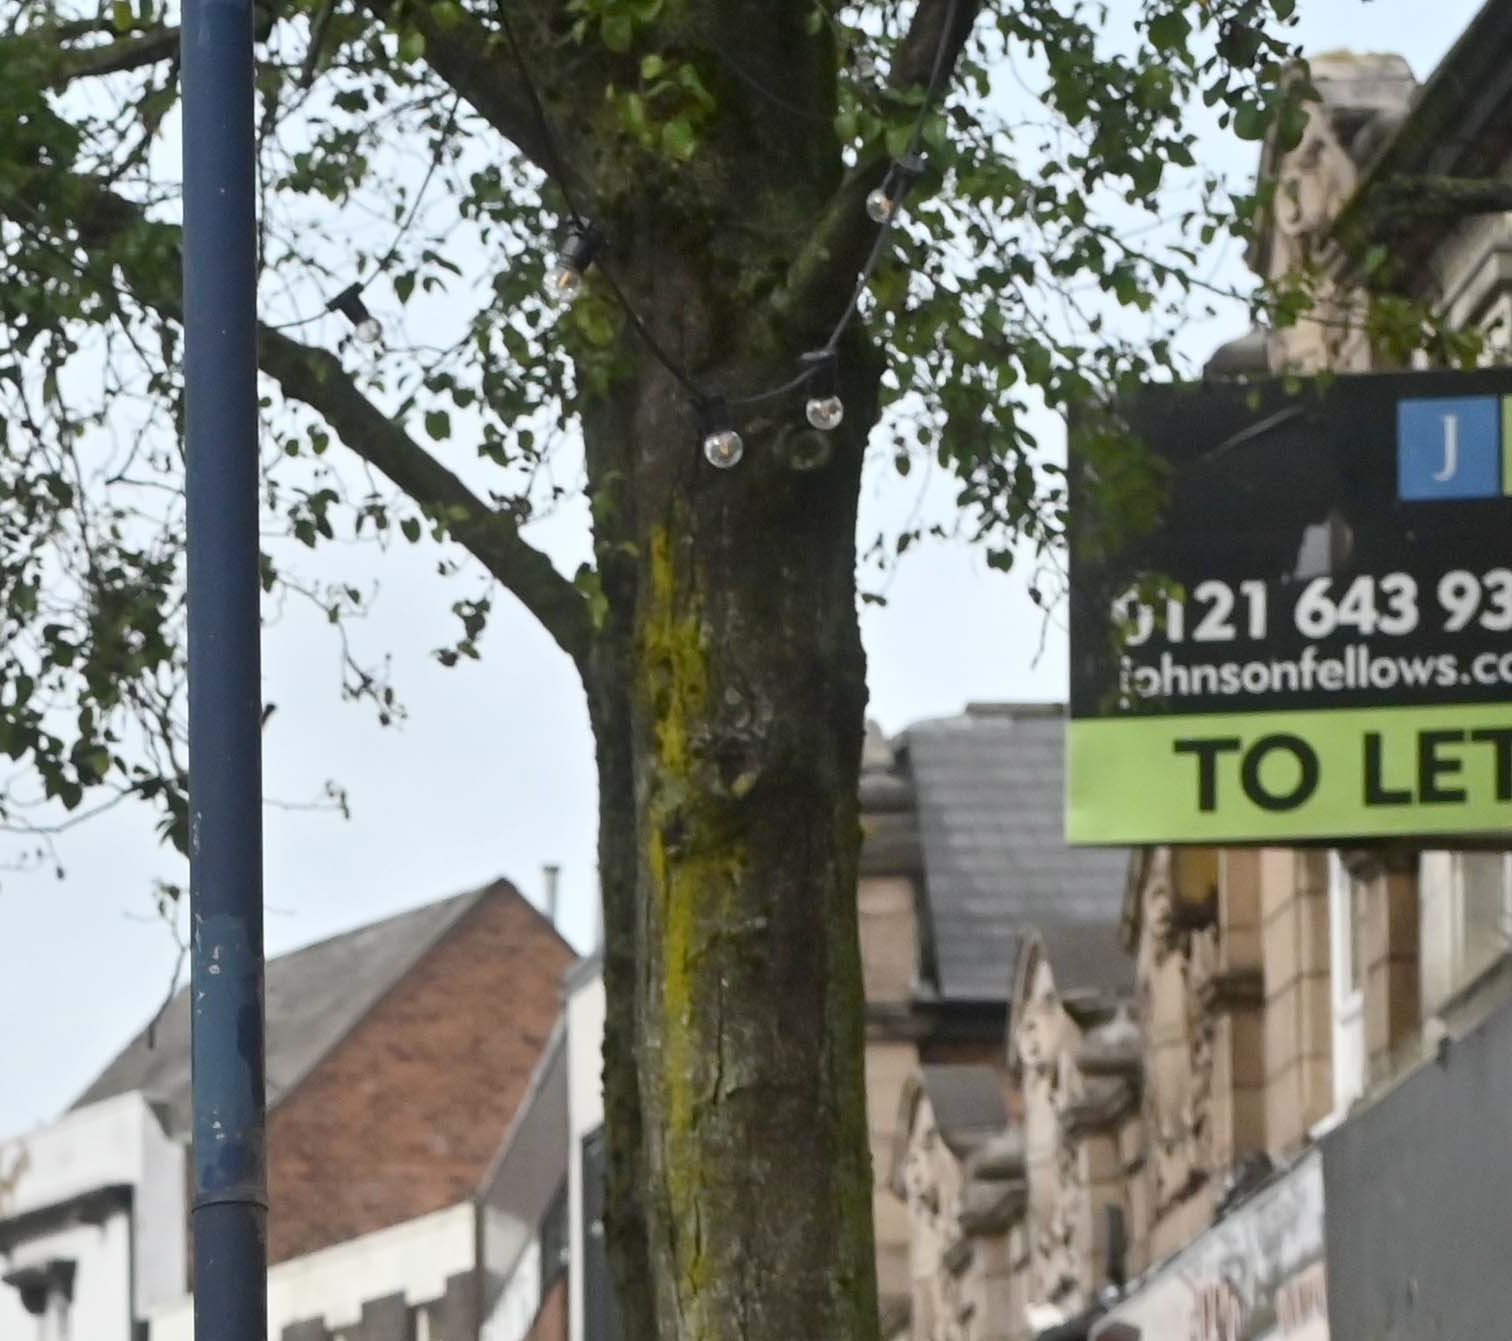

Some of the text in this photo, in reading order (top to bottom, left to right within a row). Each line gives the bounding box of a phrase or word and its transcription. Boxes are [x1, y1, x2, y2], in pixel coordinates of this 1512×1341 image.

[1433, 413, 1459, 482] J
[1111, 578, 1268, 646] 0121
[1294, 572, 1420, 639] 643
[1173, 728, 1512, 813] TO LET
